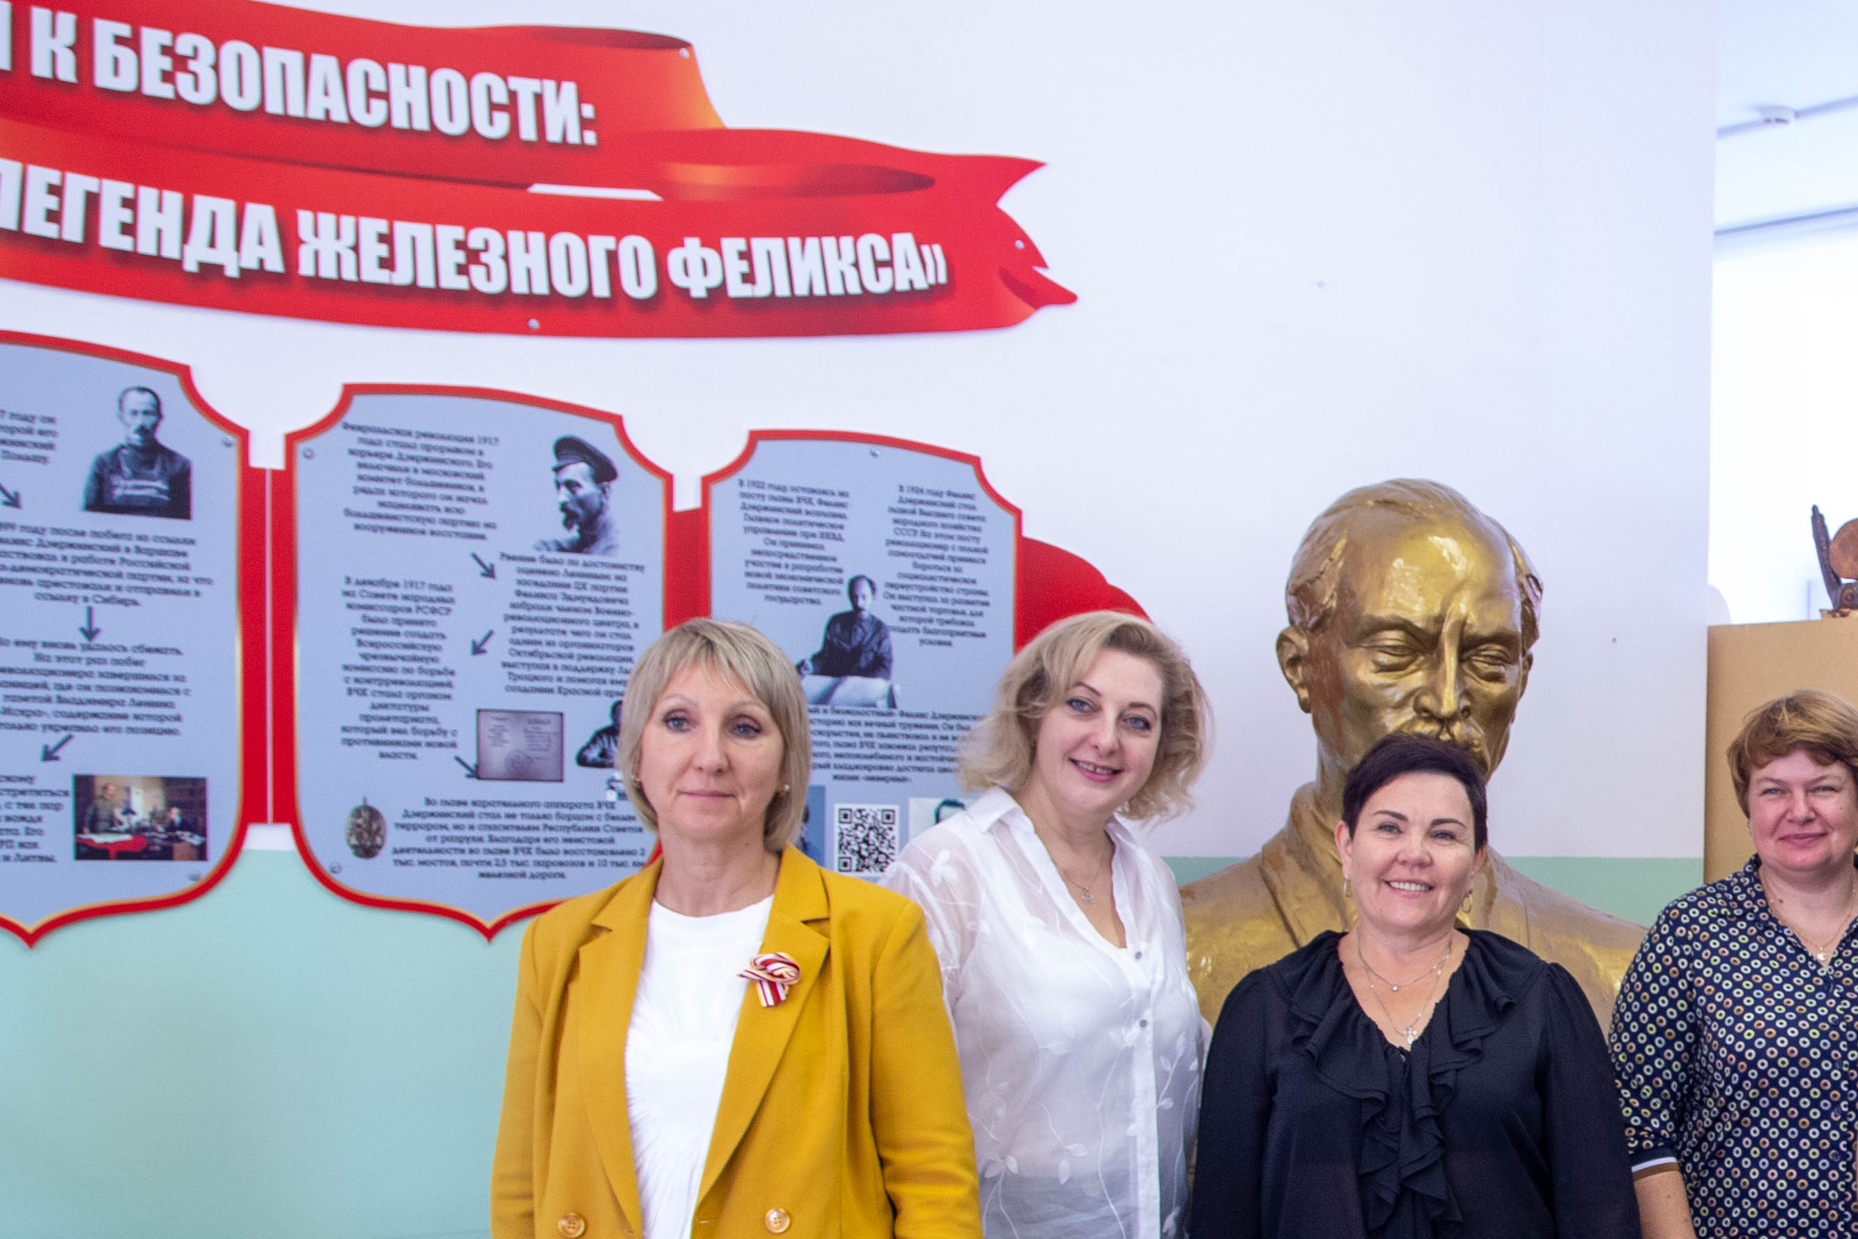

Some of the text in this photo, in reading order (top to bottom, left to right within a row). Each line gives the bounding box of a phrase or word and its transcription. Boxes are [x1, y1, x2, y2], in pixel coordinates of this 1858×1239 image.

[30, 6, 78, 84] К
[93, 18, 597, 145] БЕЗОПАСНОСТИ:
[297, 209, 662, 300] ЖЕЛЕЗНОГО
[667, 232, 948, 300] ФЕЛИКСА»
